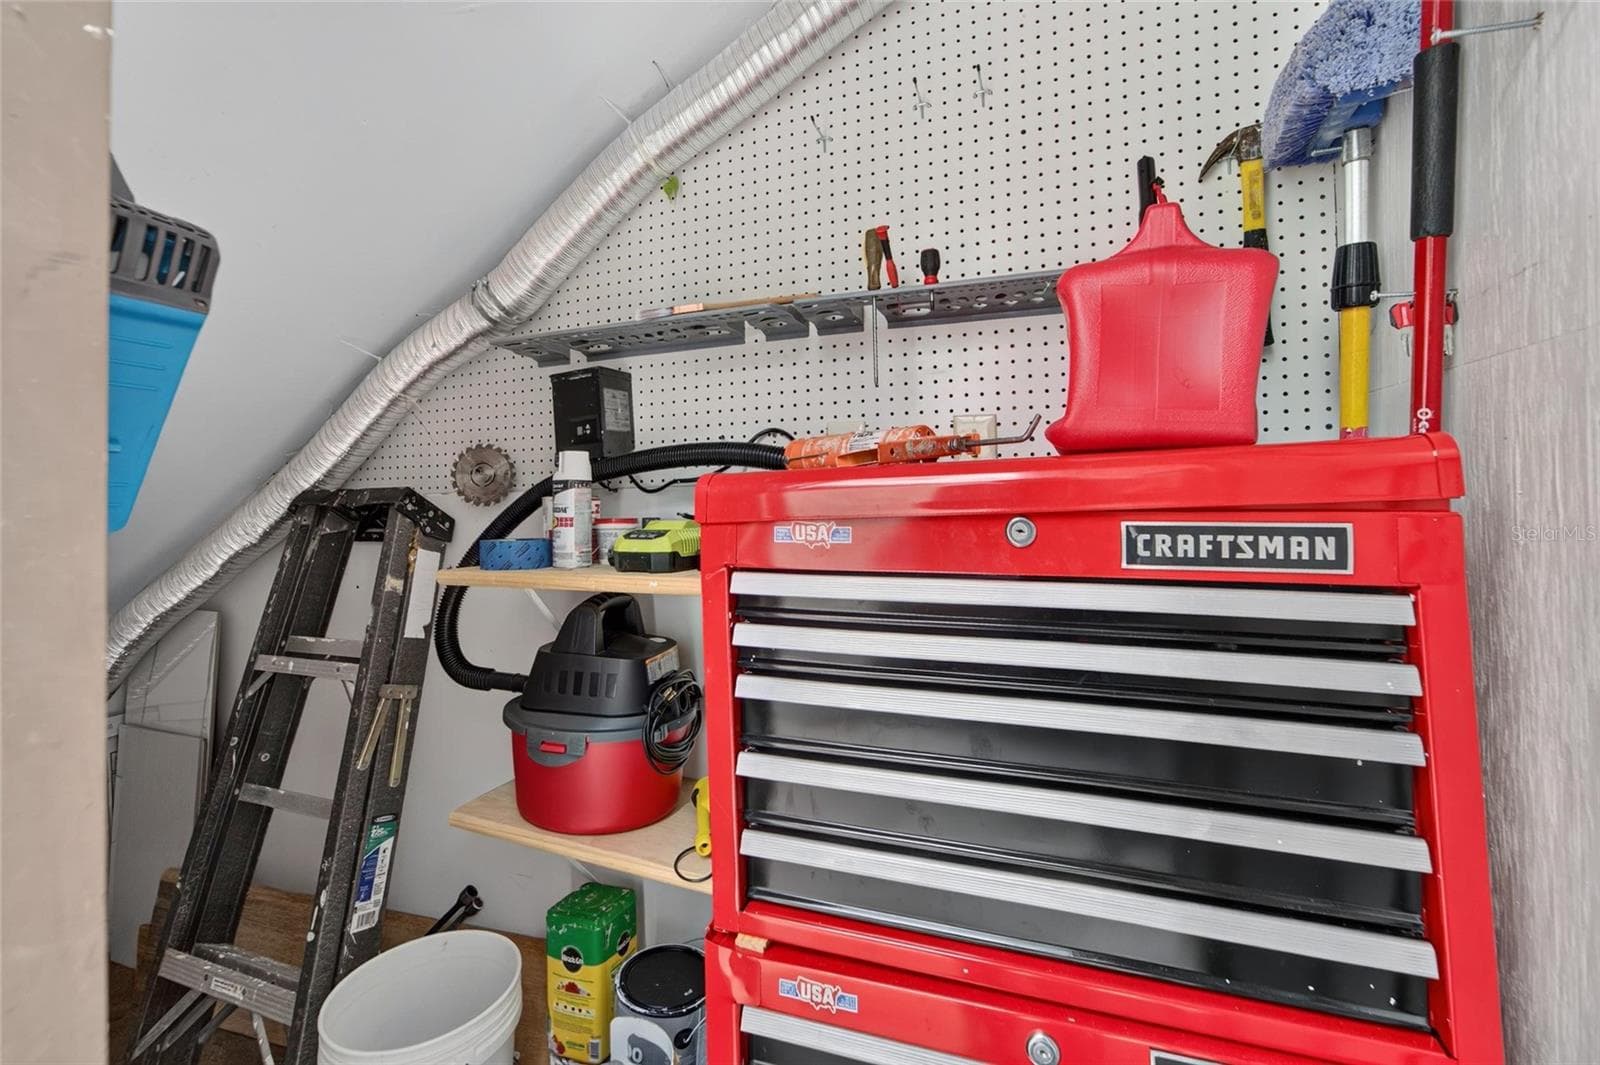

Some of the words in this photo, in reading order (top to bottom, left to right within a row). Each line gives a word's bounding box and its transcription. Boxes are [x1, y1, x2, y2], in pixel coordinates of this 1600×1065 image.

[795, 524, 829, 541] USA
[1136, 533, 1336, 561] CRAFTSMAN
[800, 982, 834, 1006] USA
